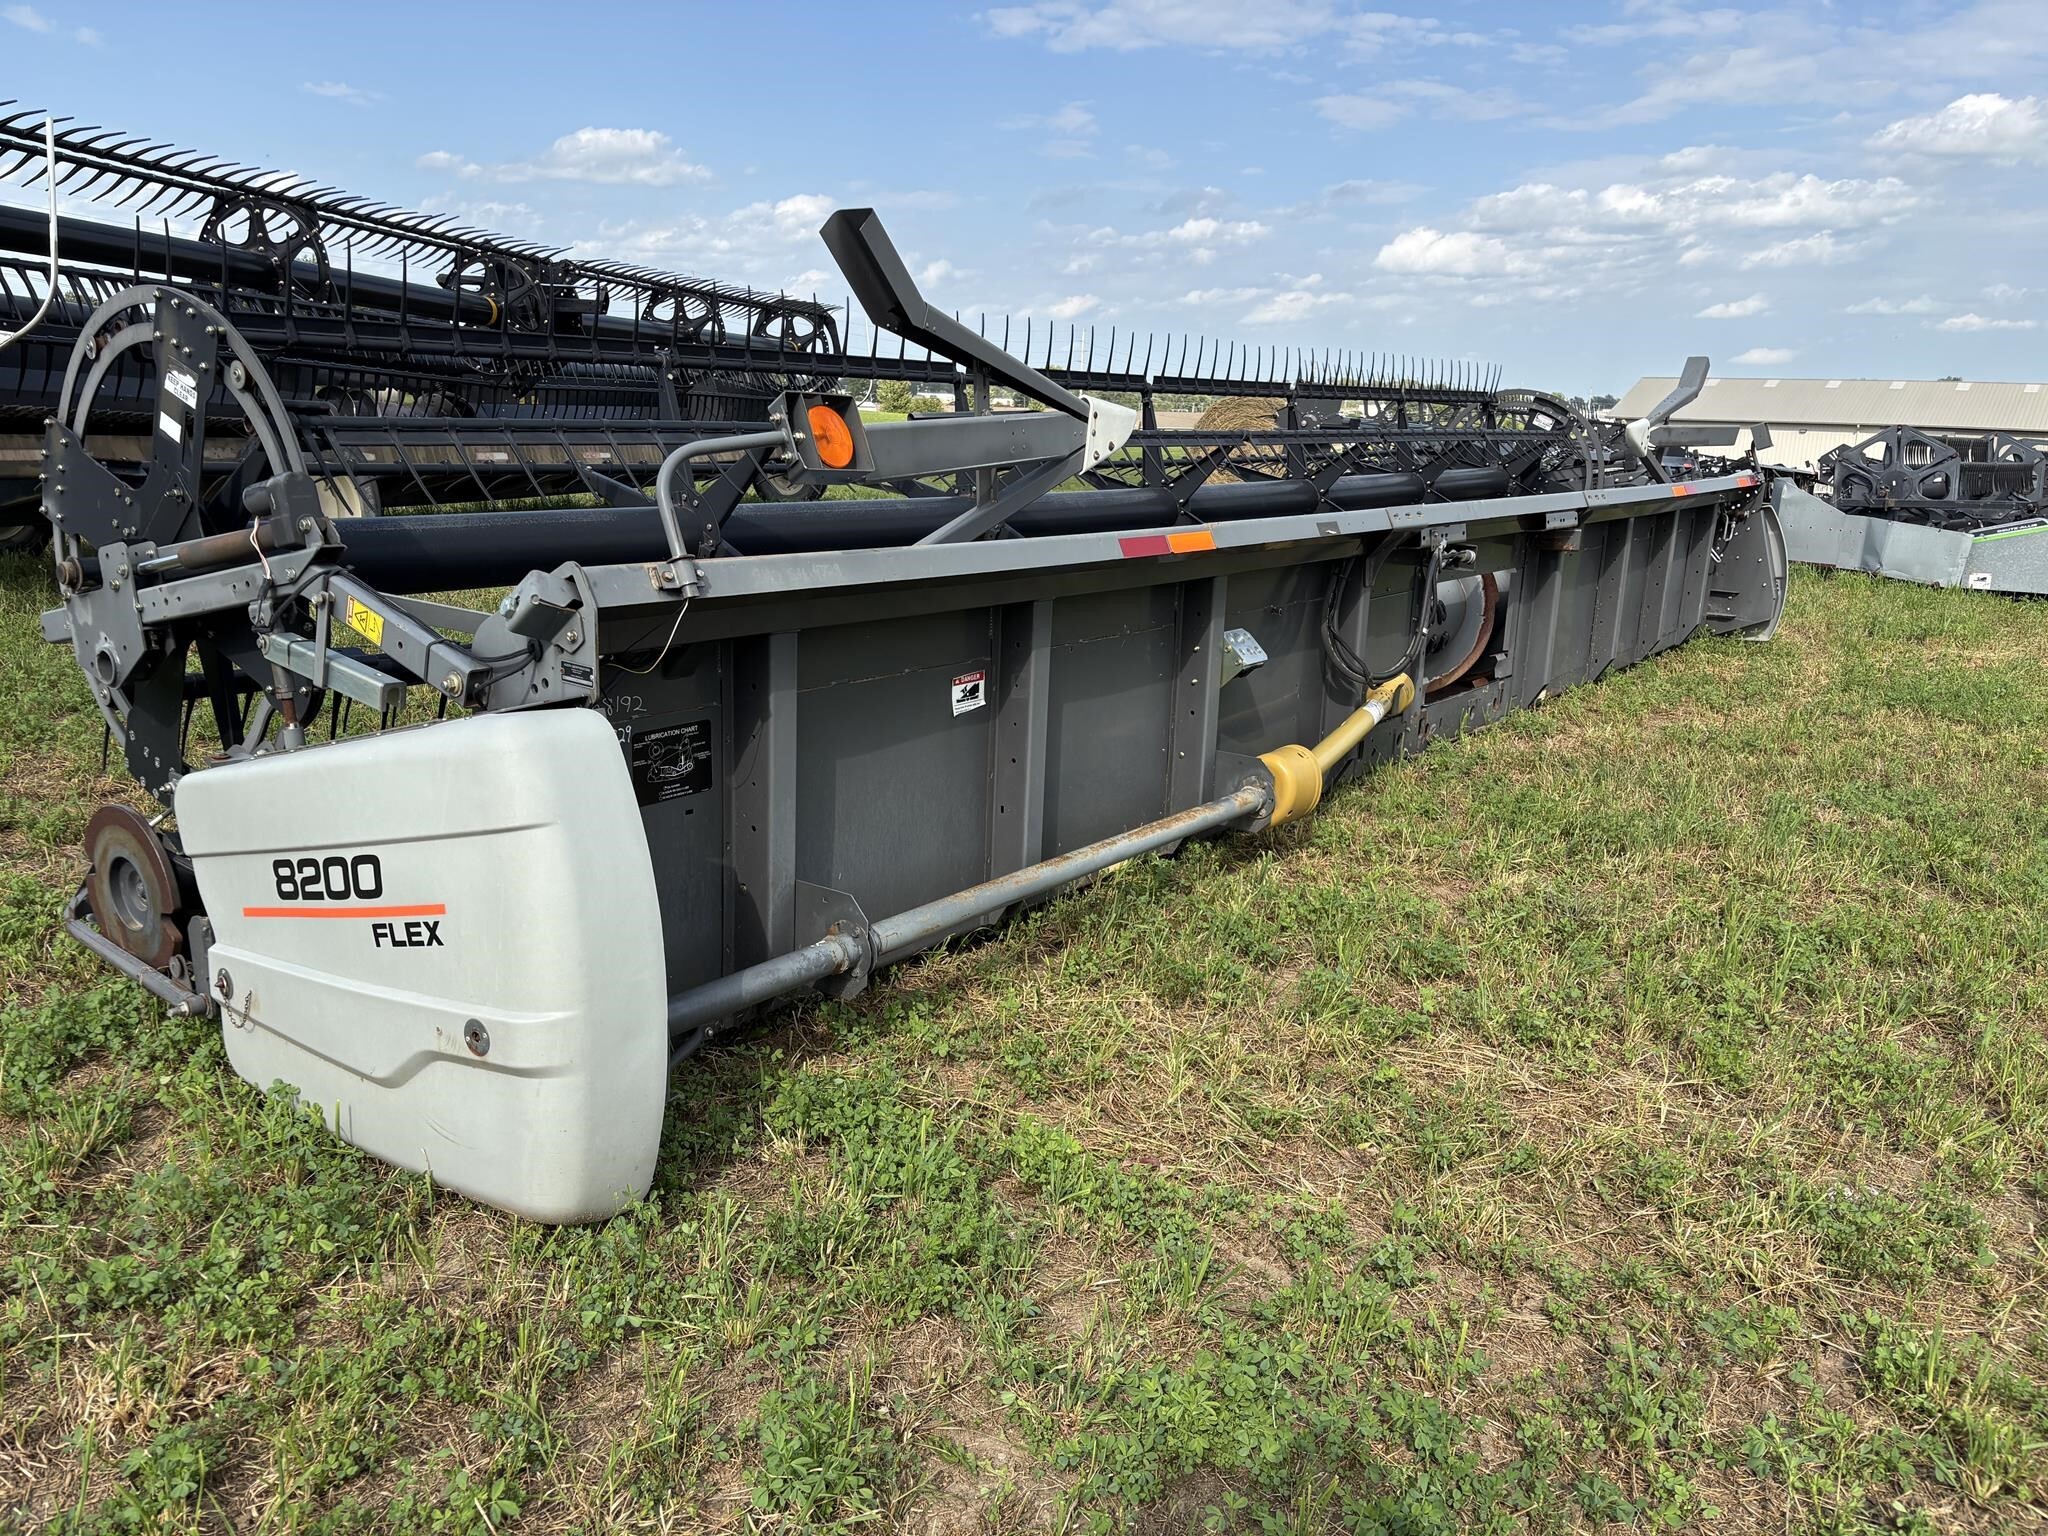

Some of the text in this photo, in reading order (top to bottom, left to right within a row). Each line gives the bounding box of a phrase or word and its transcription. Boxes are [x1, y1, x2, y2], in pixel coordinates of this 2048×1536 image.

[168, 375, 196, 399] KEEP HANDS
[174, 387, 188, 401] CLEAR
[960, 673, 980, 683] DANGER
[645, 725, 698, 741] LUBRICATION CHART
[272, 854, 383, 900] 8200
[372, 921, 444, 947] FLEX
